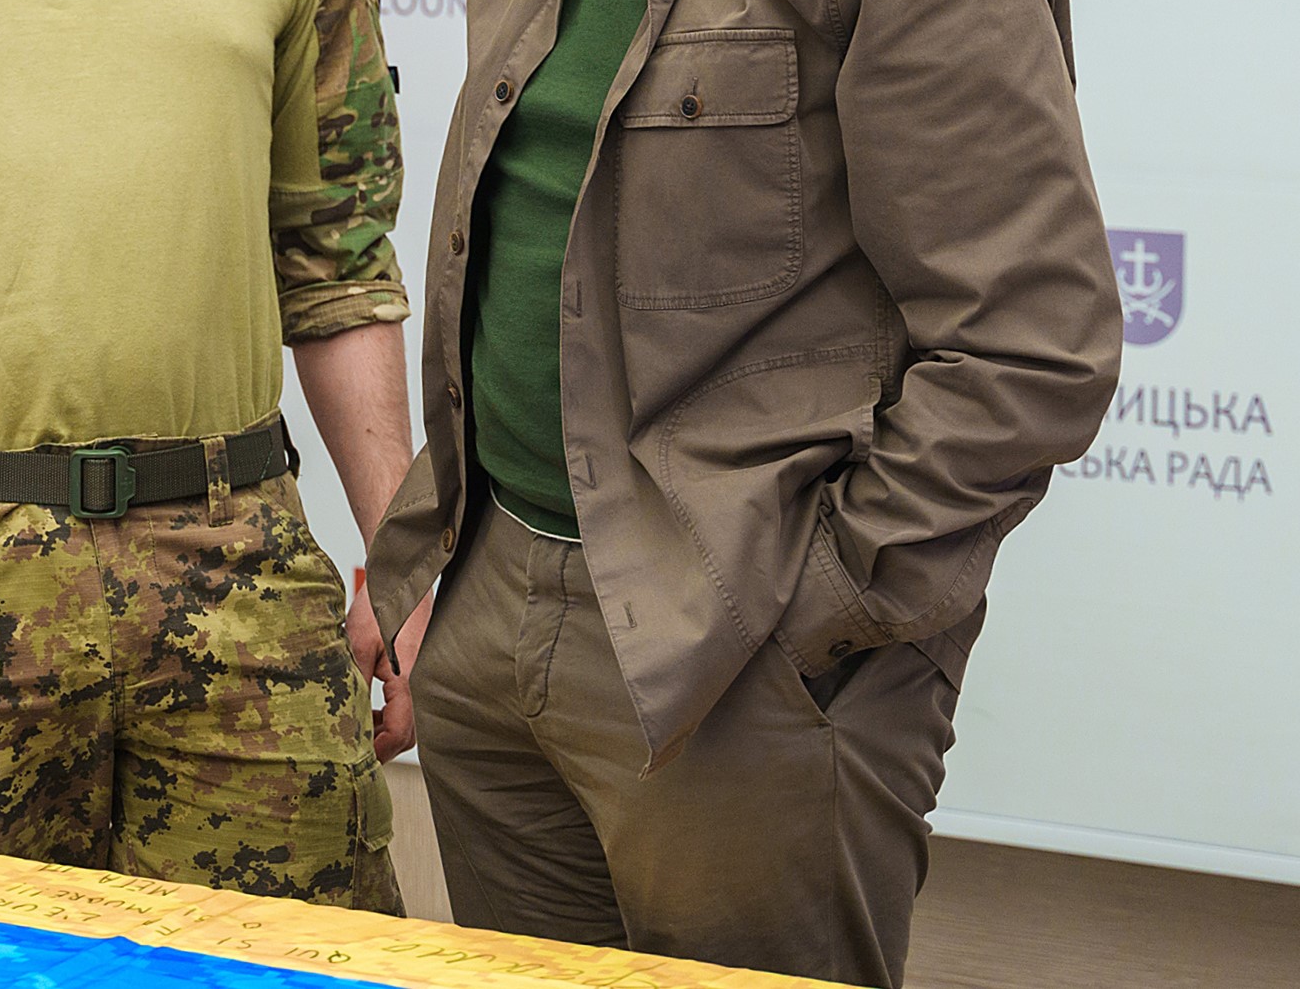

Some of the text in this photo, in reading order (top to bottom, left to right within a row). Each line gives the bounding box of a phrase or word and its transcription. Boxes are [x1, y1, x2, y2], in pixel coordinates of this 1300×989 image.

[1105, 385, 1274, 439] ИЦЬКА
[1166, 450, 1274, 501] РАДА
[217, 936, 253, 950] SI
[284, 946, 351, 964] QUI
